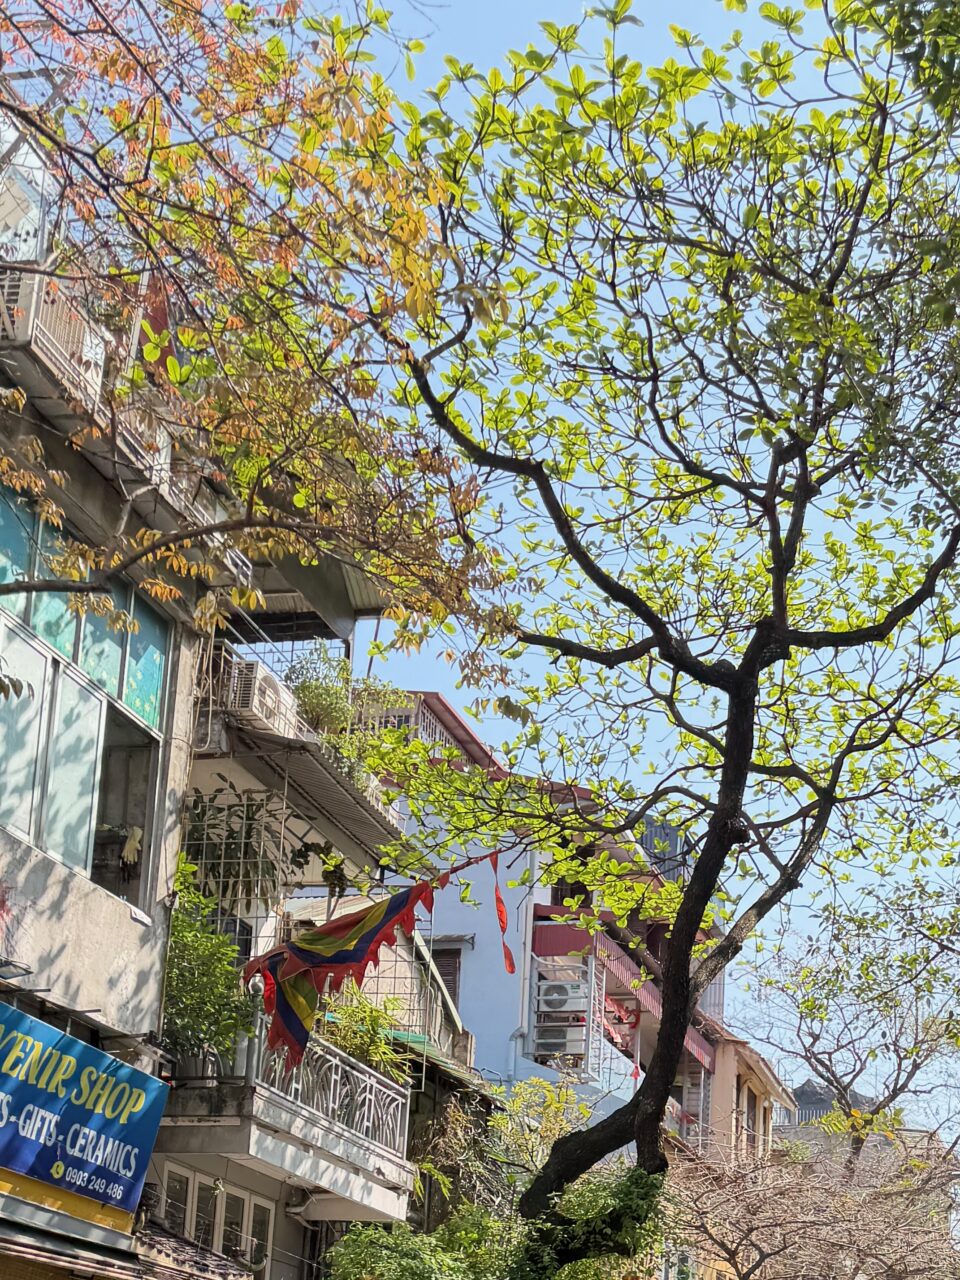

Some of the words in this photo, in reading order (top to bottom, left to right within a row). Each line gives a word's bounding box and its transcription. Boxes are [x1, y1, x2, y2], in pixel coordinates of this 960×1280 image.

[71, 1066, 146, 1124] SHOP
[18, 1103, 61, 1147] GIFTS
[66, 1123, 139, 1178] CERAMICS
[66, 1166, 88, 1187] 0903
[89, 1177, 106, 1193] 249
[106, 1183, 124, 1200] 486
